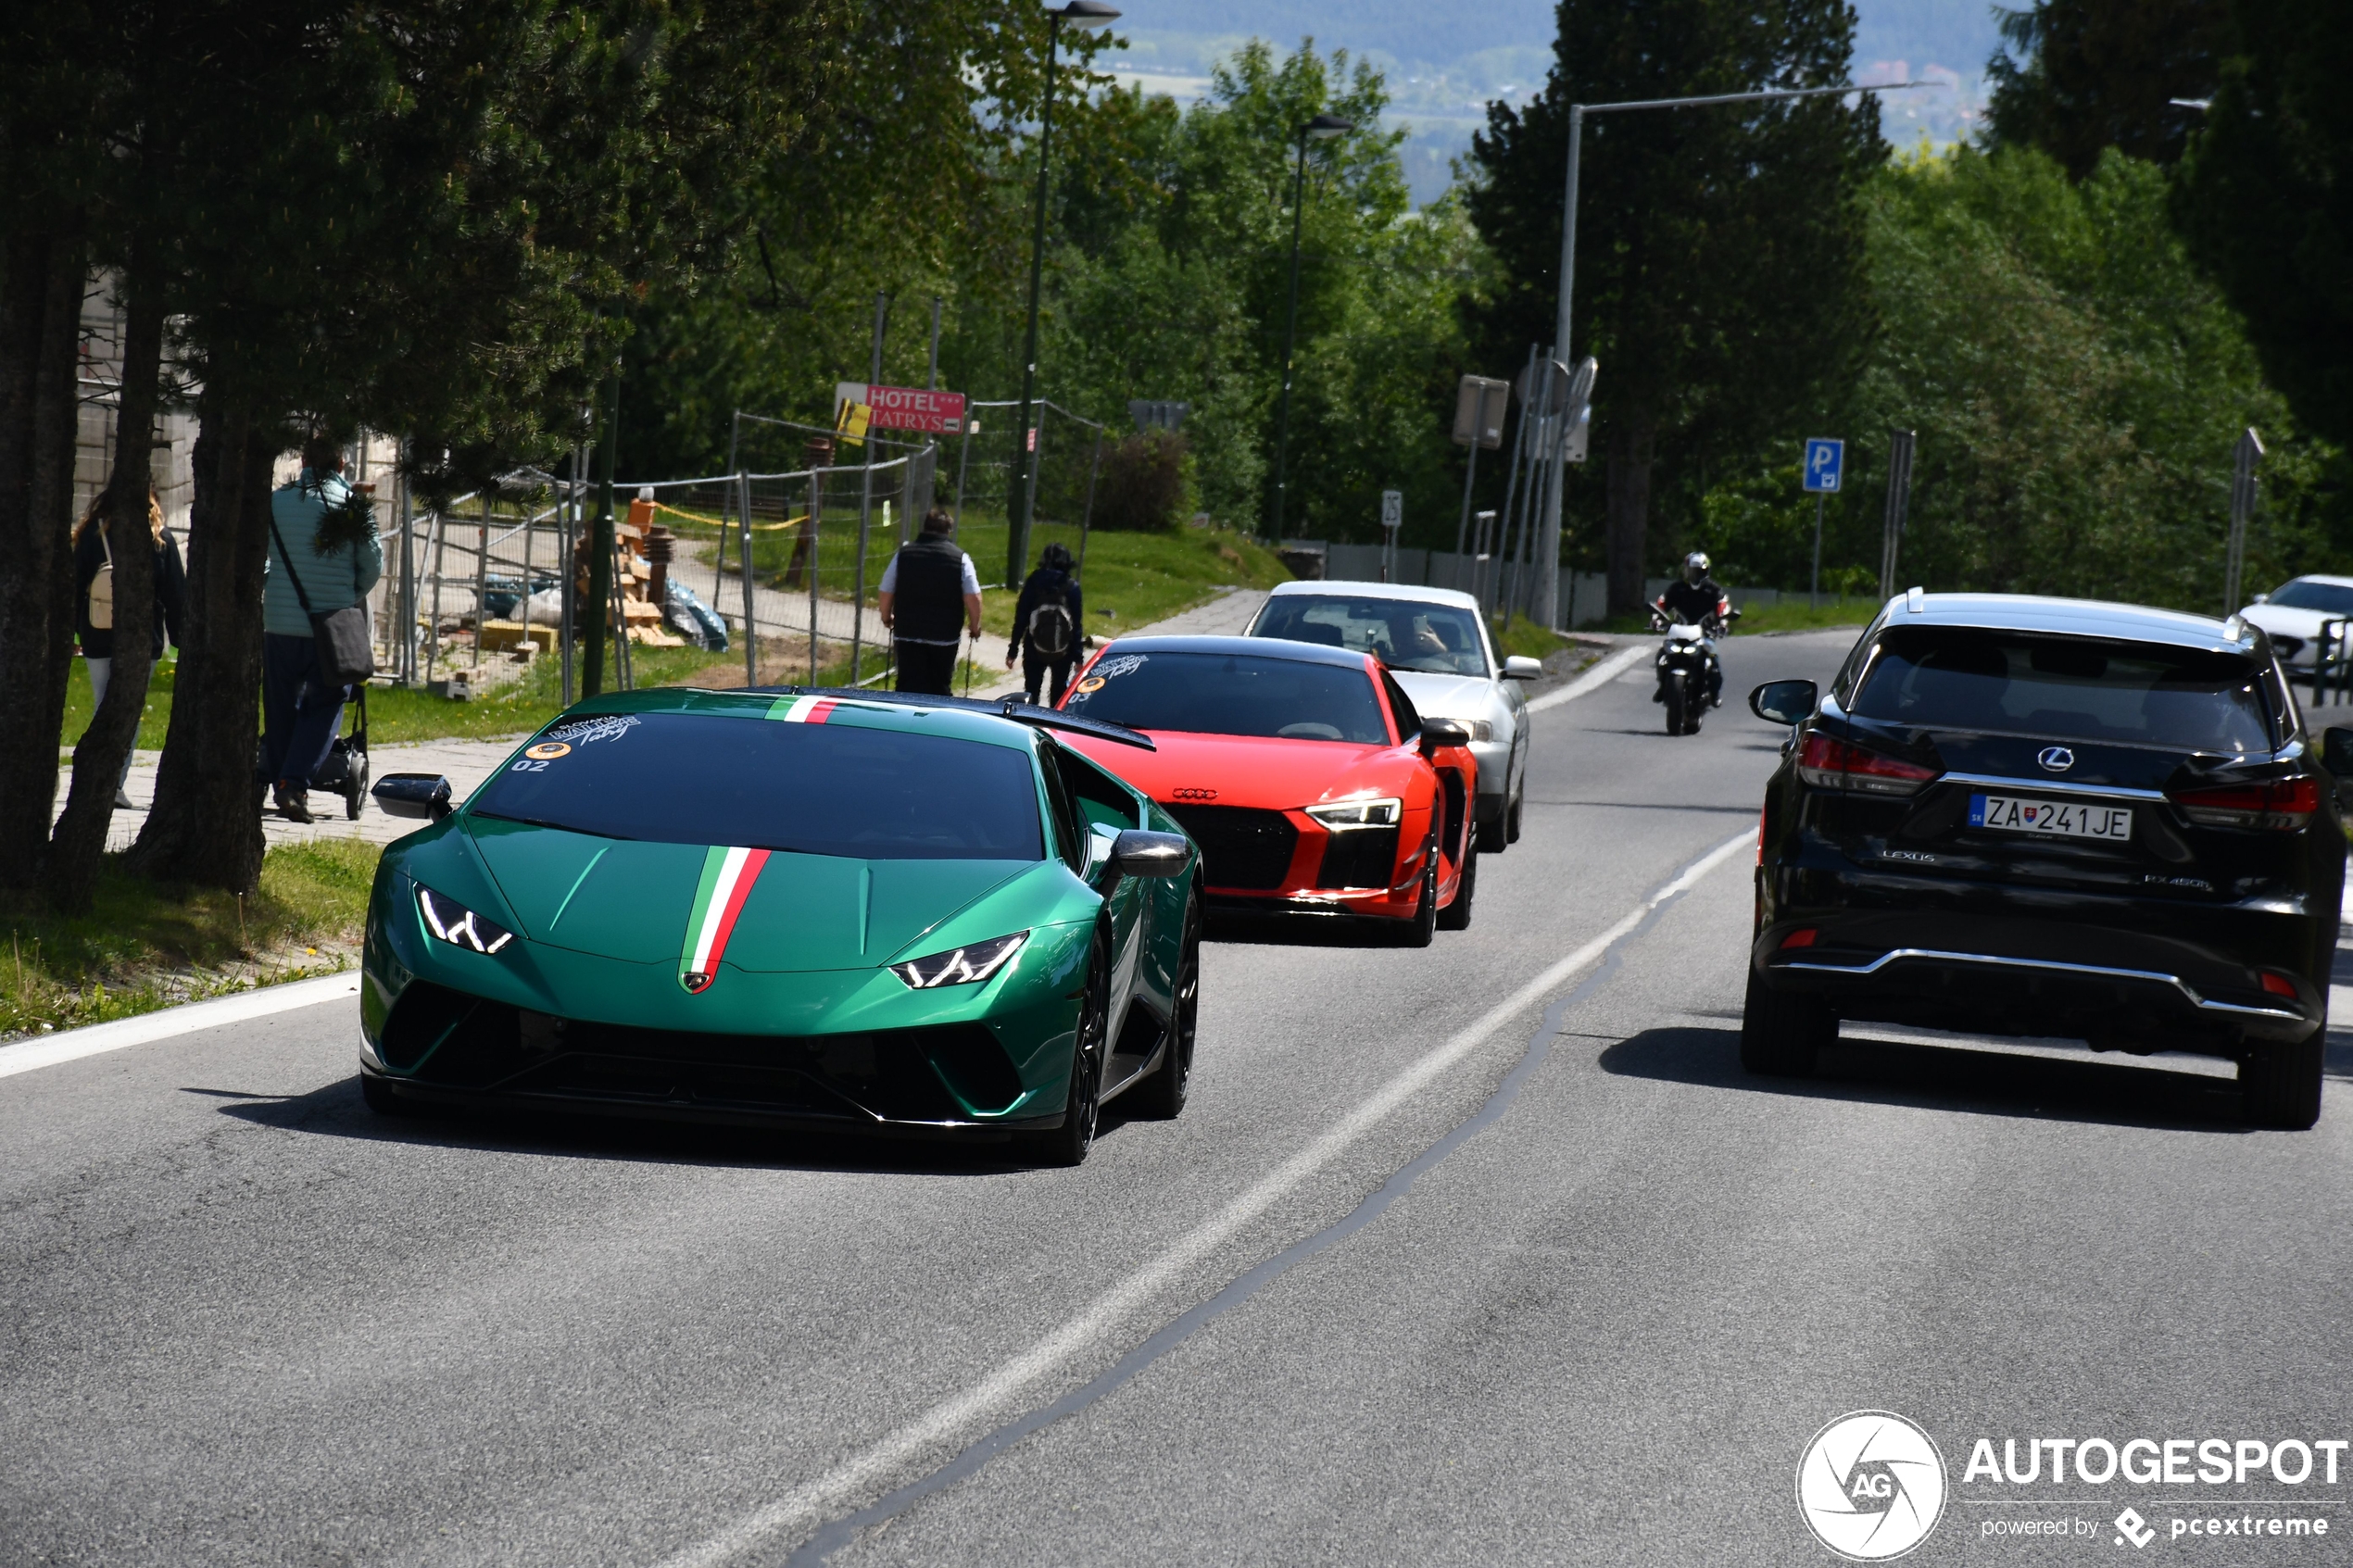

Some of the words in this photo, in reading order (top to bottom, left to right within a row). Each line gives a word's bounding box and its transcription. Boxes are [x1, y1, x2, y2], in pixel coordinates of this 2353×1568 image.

[871, 390, 940, 412] HOTEL
[871, 409, 941, 431] TATRYS
[1812, 445, 1832, 474] P
[1068, 692, 1091, 704] 03
[511, 760, 550, 772] 02
[1971, 813, 1982, 822] SK
[1987, 799, 2020, 827] ZA
[2037, 804, 2128, 837] 241JE
[1882, 850, 1935, 862] LEXUS
